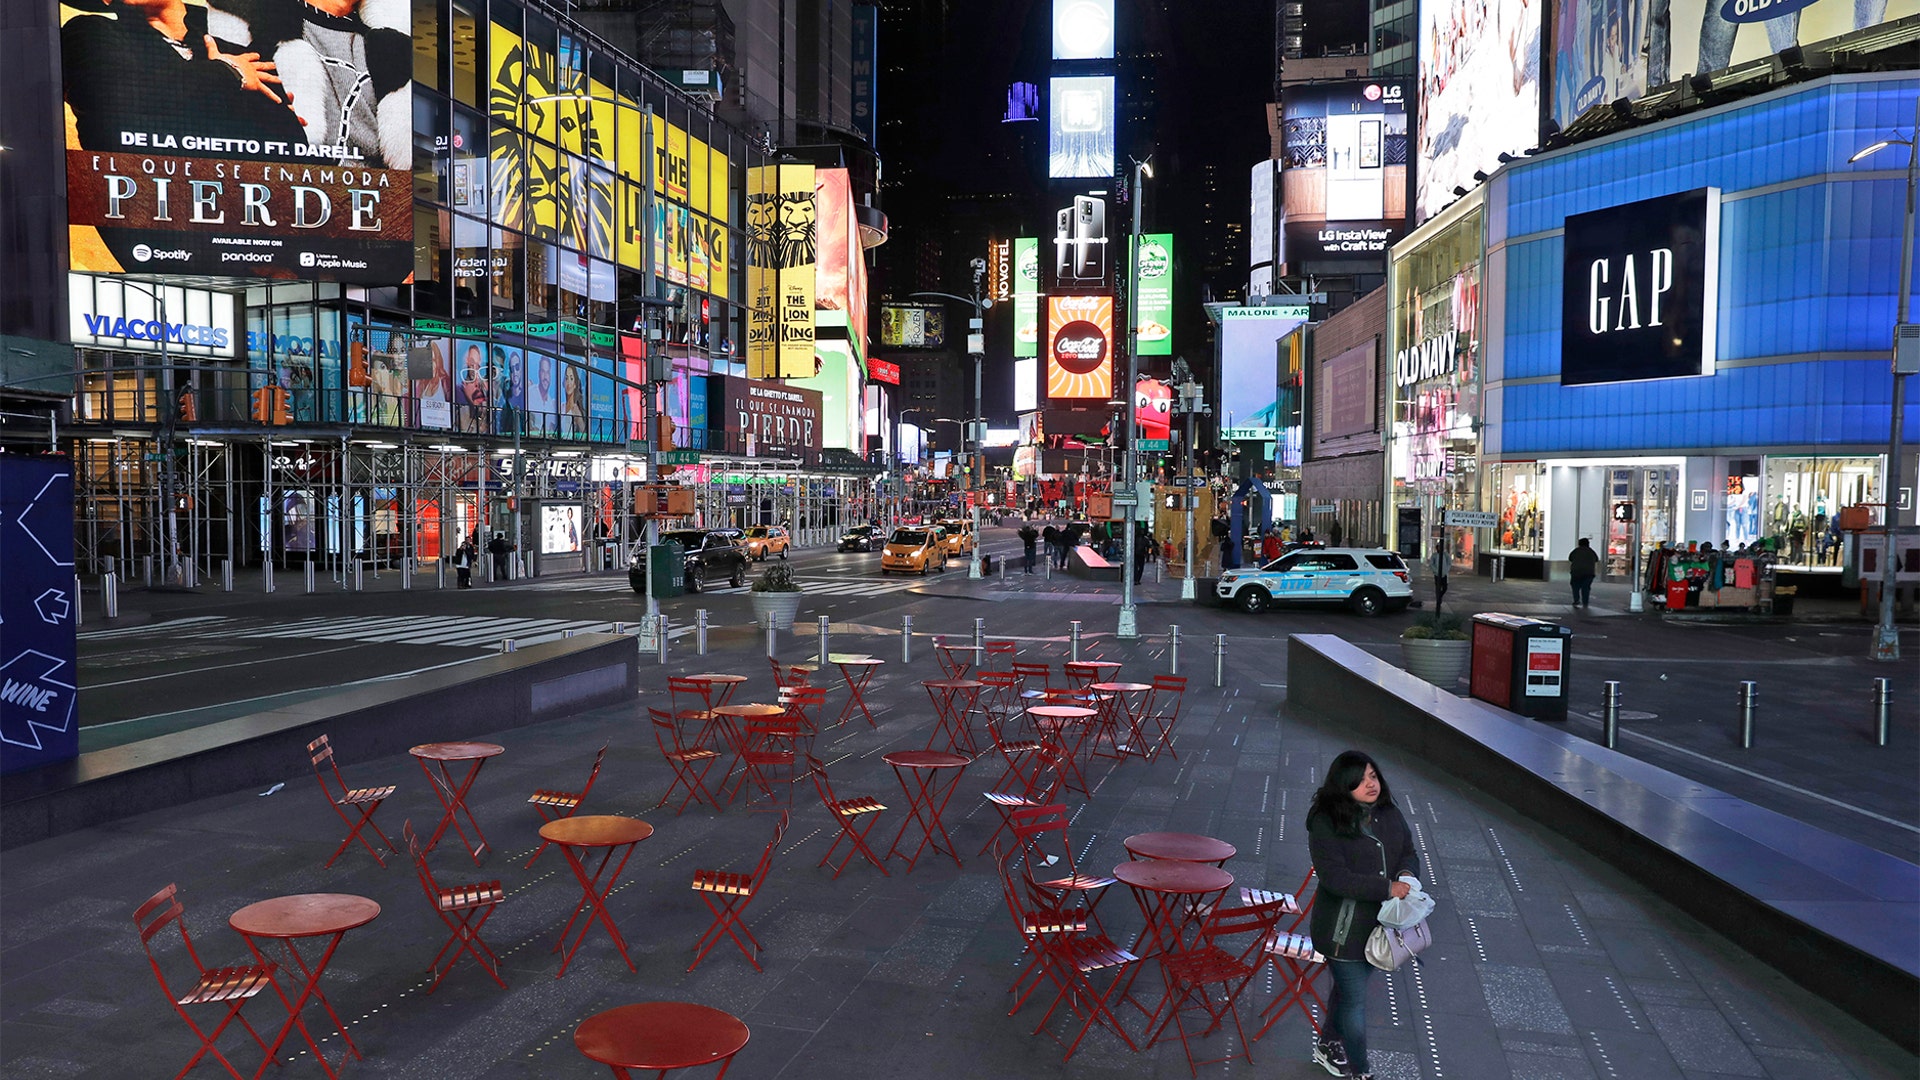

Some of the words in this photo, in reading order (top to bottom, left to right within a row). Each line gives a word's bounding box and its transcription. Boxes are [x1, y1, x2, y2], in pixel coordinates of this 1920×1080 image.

[853, 20, 870, 117] TIMES
[1383, 86, 1401, 98] LG
[121, 131, 147, 147] DE
[152, 134, 178, 148] LA
[182, 136, 260, 154] GHETTO
[264, 141, 290, 156] FT.
[294, 143, 364, 160] DARELL
[92, 155, 117, 172] EL
[142, 158, 192, 176] QUE
[215, 163, 241, 179] SE
[264, 166, 390, 187] ENAMORA
[657, 146, 687, 189] THE
[103, 175, 382, 232] PIERDE
[212, 237, 252, 246] AVAILABLE
[253, 239, 270, 247] NOW
[1318, 230, 1335, 241] LG
[153, 249, 192, 261] Spotify
[1341, 240, 1367, 251] Craft
[221, 252, 274, 262] pandora
[316, 259, 340, 269] Apple
[342, 260, 367, 269] Music
[998, 239, 1009, 301] NOVOTEL
[786, 295, 805, 305] THE
[1589, 246, 1674, 335] GAP
[783, 307, 809, 323] LION
[84, 313, 229, 348] VIACOMCBS
[781, 323, 813, 342] KING
[911, 310, 922, 344] FROZEN
[1397, 345, 1420, 388] OLD
[1420, 330, 1459, 380] NAVY
[764, 388, 782, 399] GHETTO
[735, 398, 744, 410] EL
[749, 400, 764, 412] QUE
[769, 402, 777, 414] SE
[781, 404, 815, 418] ENAMORA
[738, 411, 813, 447] PIERDE
[500, 458, 588, 477] SECHERS
[668, 453, 676, 463] W
[680, 453, 690, 463] 44
[1279, 578, 1313, 590] NYPD
[1, 677, 57, 713] WINE
